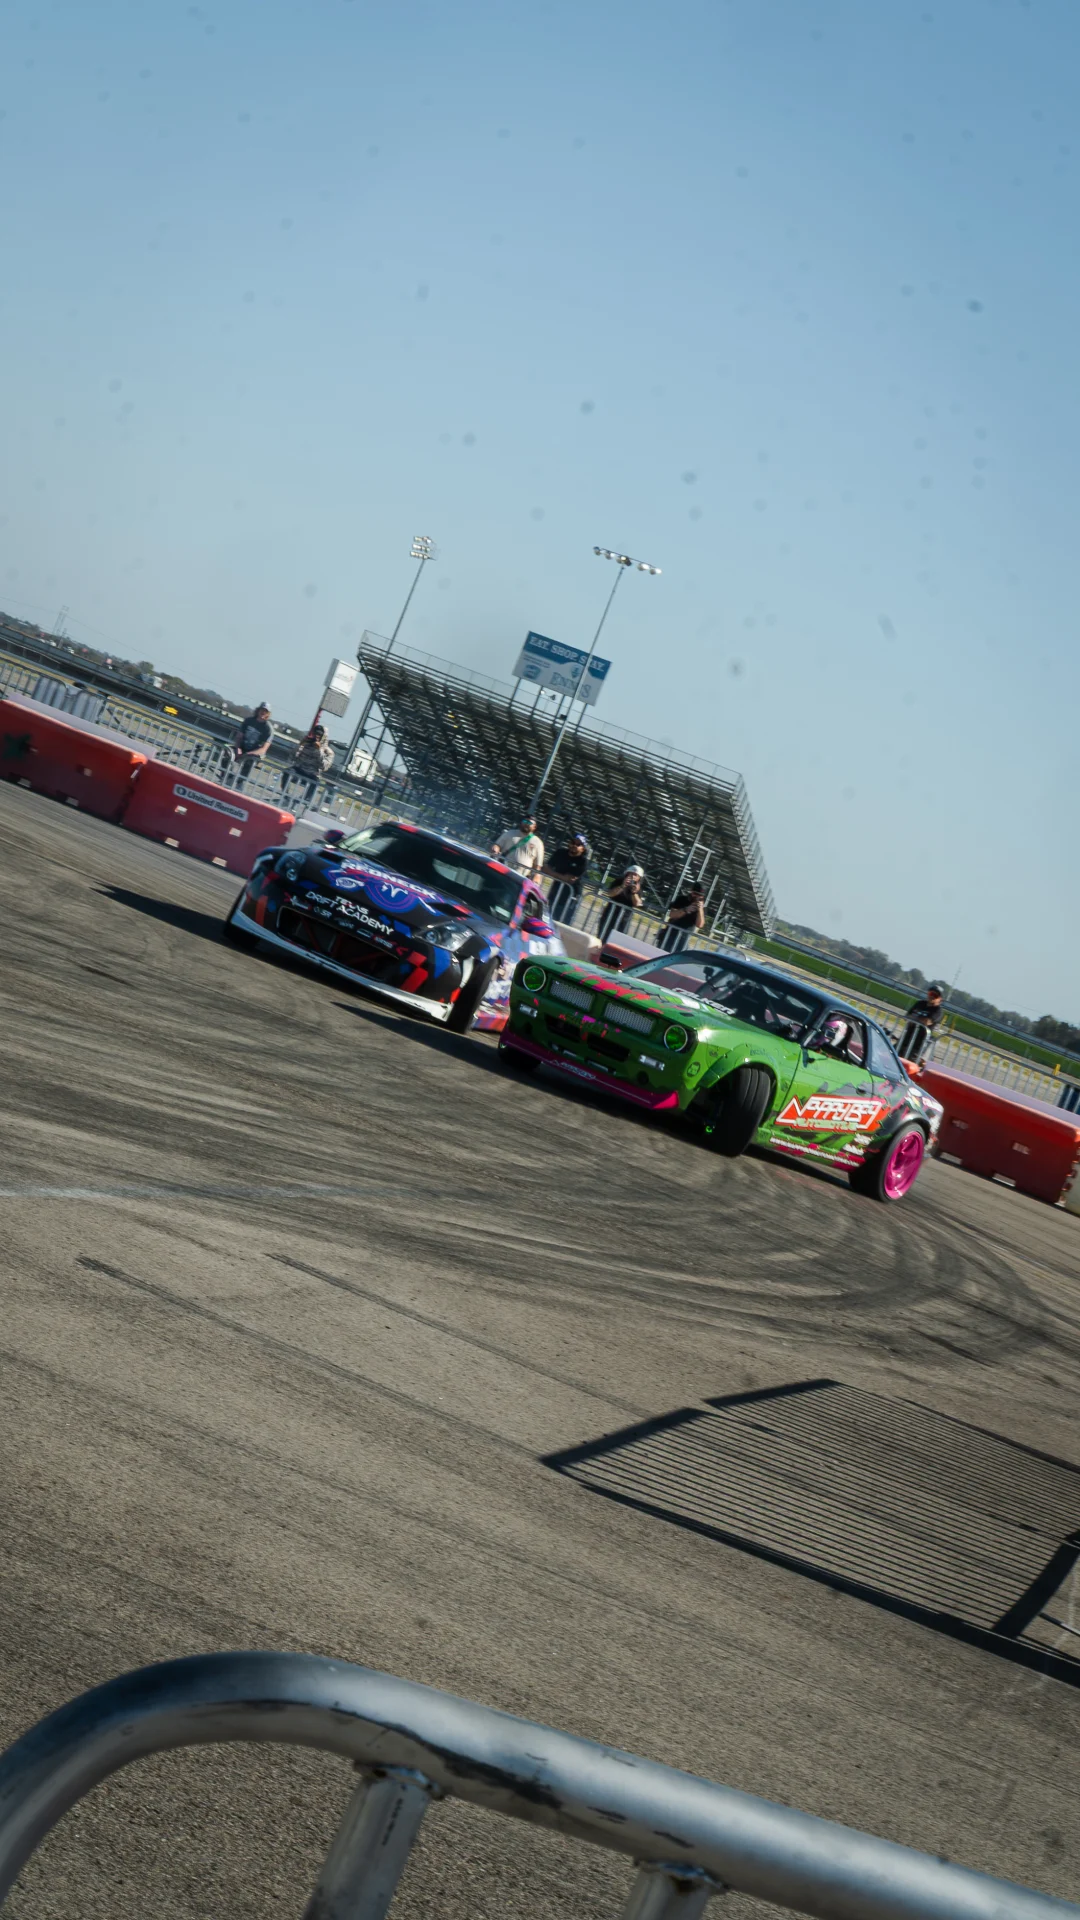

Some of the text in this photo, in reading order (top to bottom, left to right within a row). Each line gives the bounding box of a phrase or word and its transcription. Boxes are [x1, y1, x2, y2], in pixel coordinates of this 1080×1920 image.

[187, 791, 244, 818] United Rentals
[340, 859, 438, 901] REDNECK
[305, 891, 340, 908] DRIFT
[336, 904, 395, 936] ACADEMY
[335, 896, 370, 915] TEXAS
